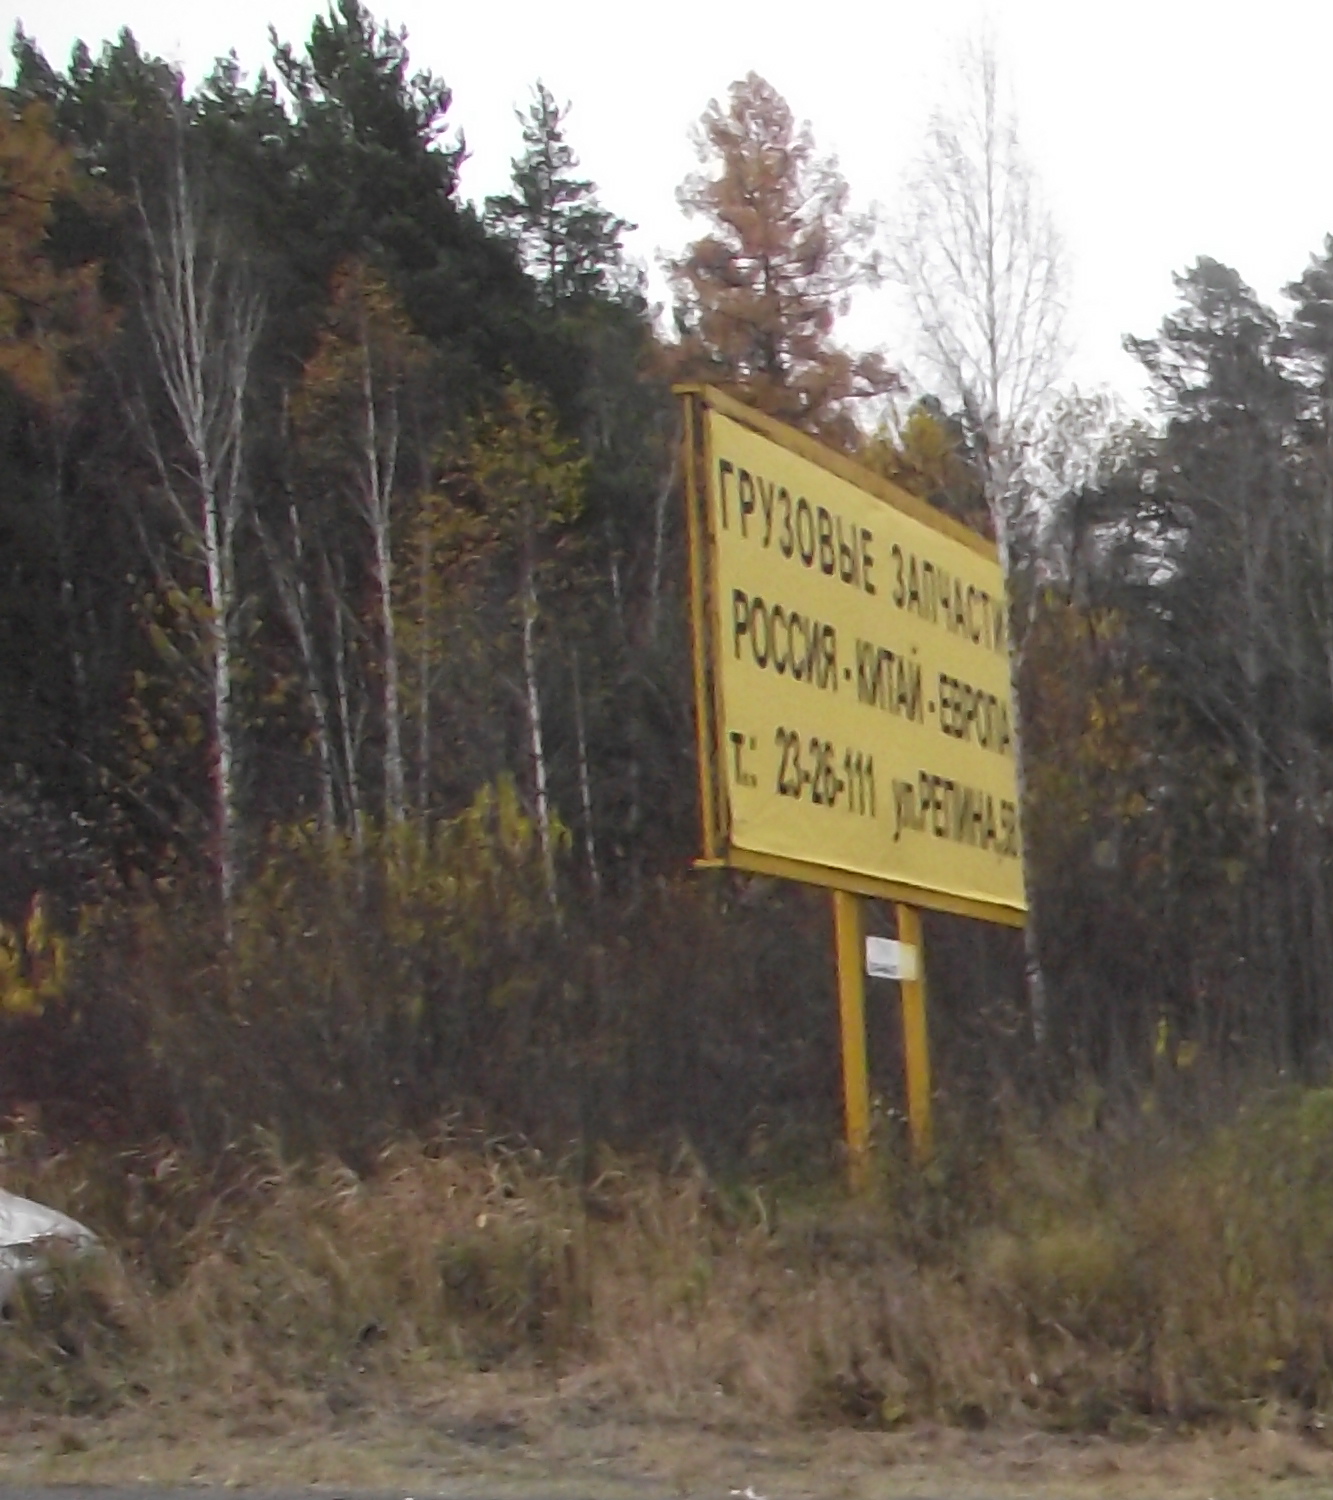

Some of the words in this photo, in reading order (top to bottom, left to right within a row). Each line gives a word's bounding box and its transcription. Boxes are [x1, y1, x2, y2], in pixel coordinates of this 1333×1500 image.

[719, 458, 876, 595] ГРУЗОВЫЕ
[733, 588, 838, 692] РОССИЯ
[856, 638, 924, 725] КИТАЙ
[939, 672, 1013, 755] ЕВРОПА
[775, 726, 876, 817] 23-26-111
